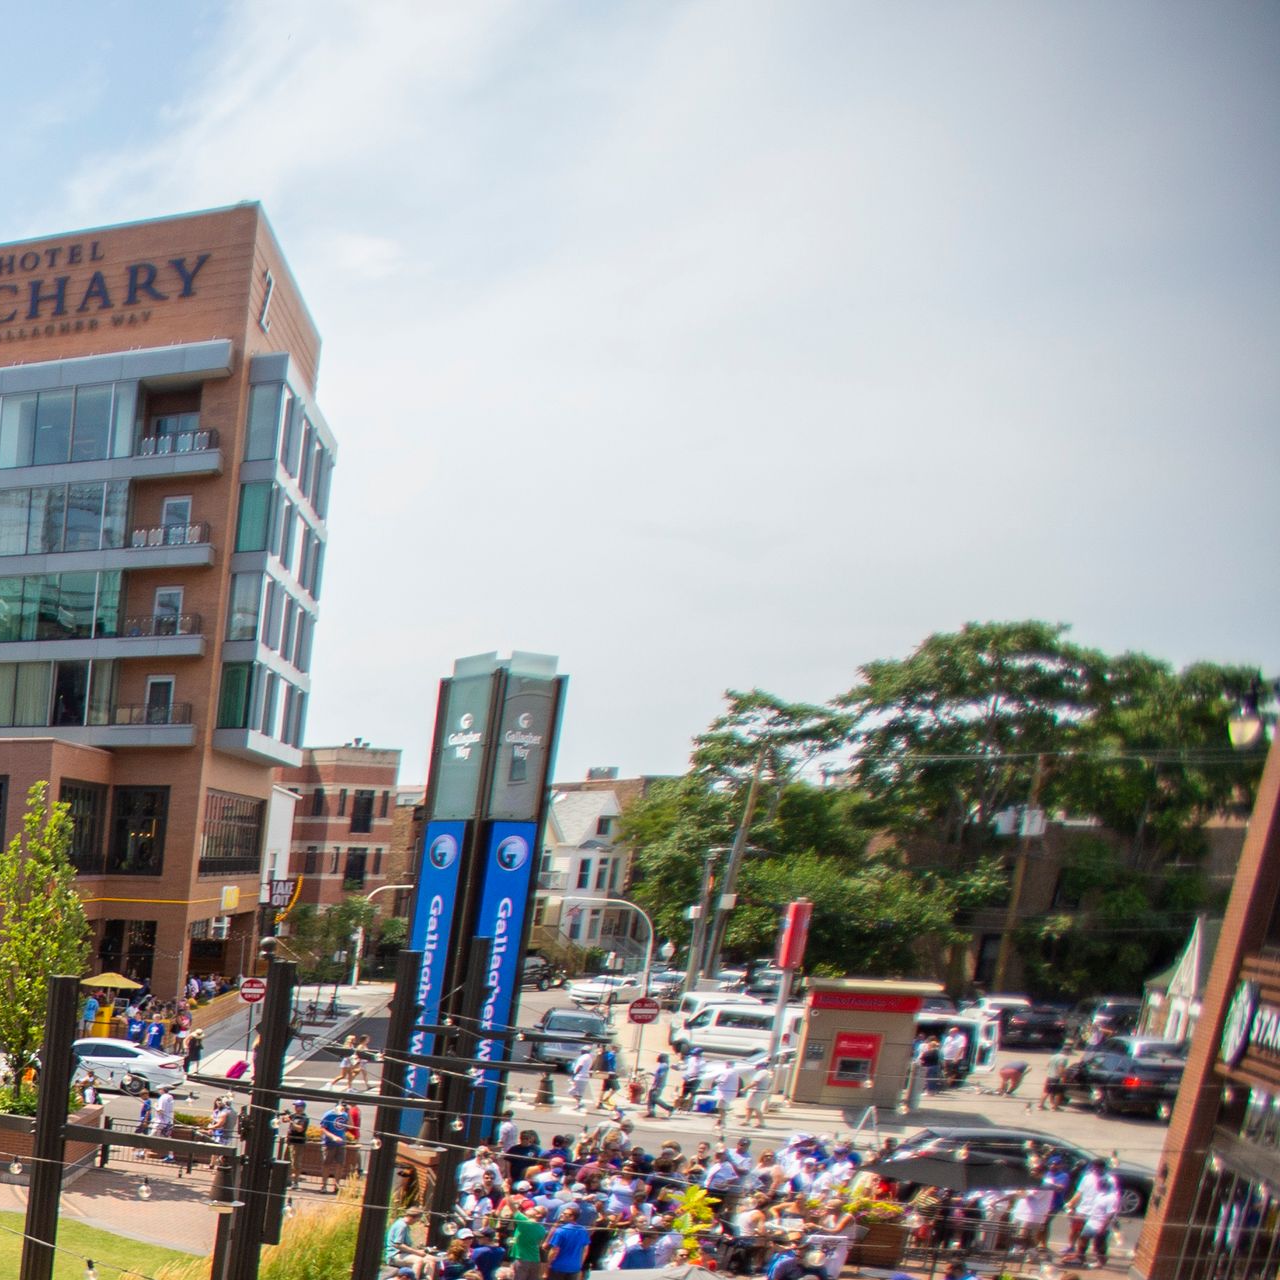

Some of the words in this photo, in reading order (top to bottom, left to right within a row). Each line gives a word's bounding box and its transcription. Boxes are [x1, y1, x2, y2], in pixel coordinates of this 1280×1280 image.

[110, 310, 153, 327] WAY
[448, 731, 482, 747] Gallagher
[505, 730, 542, 745] Gallagher
[456, 746, 472, 760] Way
[514, 746, 531, 760] Way
[272, 882, 295, 895] TAKE
[271, 894, 291, 906] OUT
